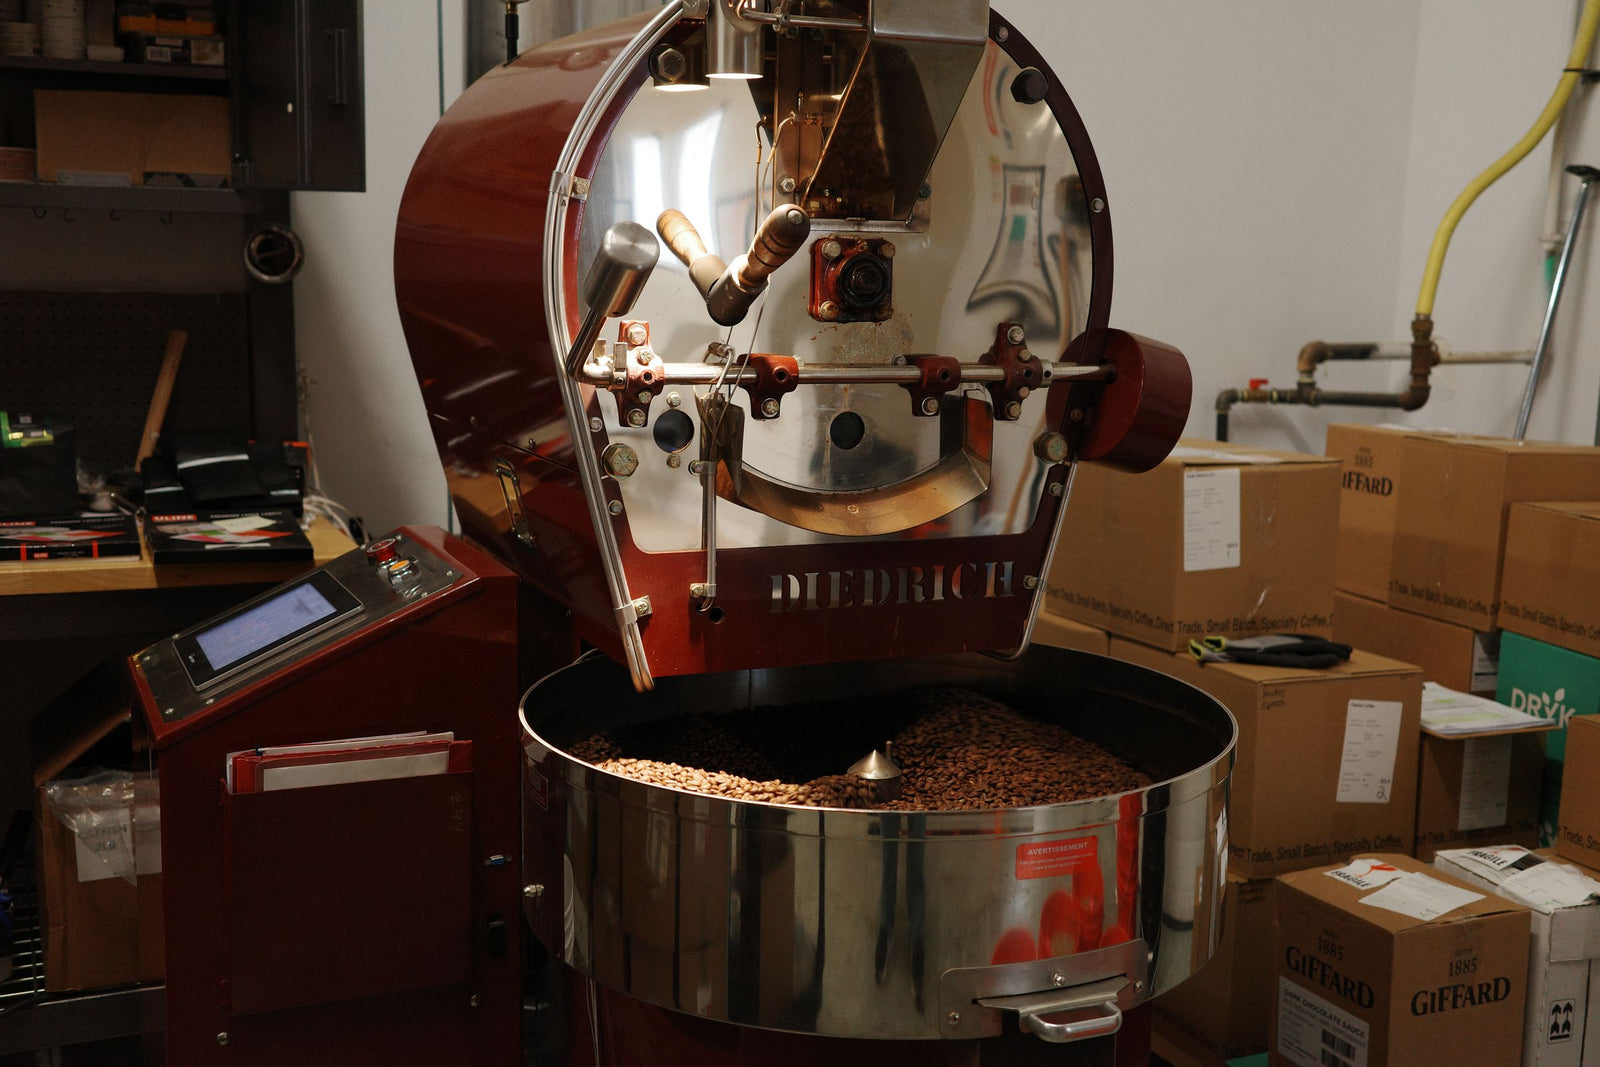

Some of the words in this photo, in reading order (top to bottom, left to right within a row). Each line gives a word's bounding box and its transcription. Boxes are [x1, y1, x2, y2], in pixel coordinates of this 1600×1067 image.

[1342, 470, 1393, 496] IFFARD
[769, 561, 1017, 613] DIEDRICH
[1206, 618, 1231, 633] Small
[1261, 615, 1298, 632] Specialty
[1028, 841, 1088, 855] AVERTISSEMENT
[1276, 846, 1301, 860] Small
[1333, 837, 1371, 855] Specialty
[1467, 850, 1509, 867] FRAGILE
[1331, 870, 1372, 888] FRAGILE
[1317, 937, 1344, 961] 1885
[1286, 946, 1375, 1009] GIFFARD
[1448, 957, 1478, 977] 1885
[1410, 977, 1511, 1016] GIFFARD
[1284, 988, 1301, 1002] DARK
[1302, 998, 1341, 1025] CHOCOLATE
[1341, 1020, 1366, 1039] SAUCE
